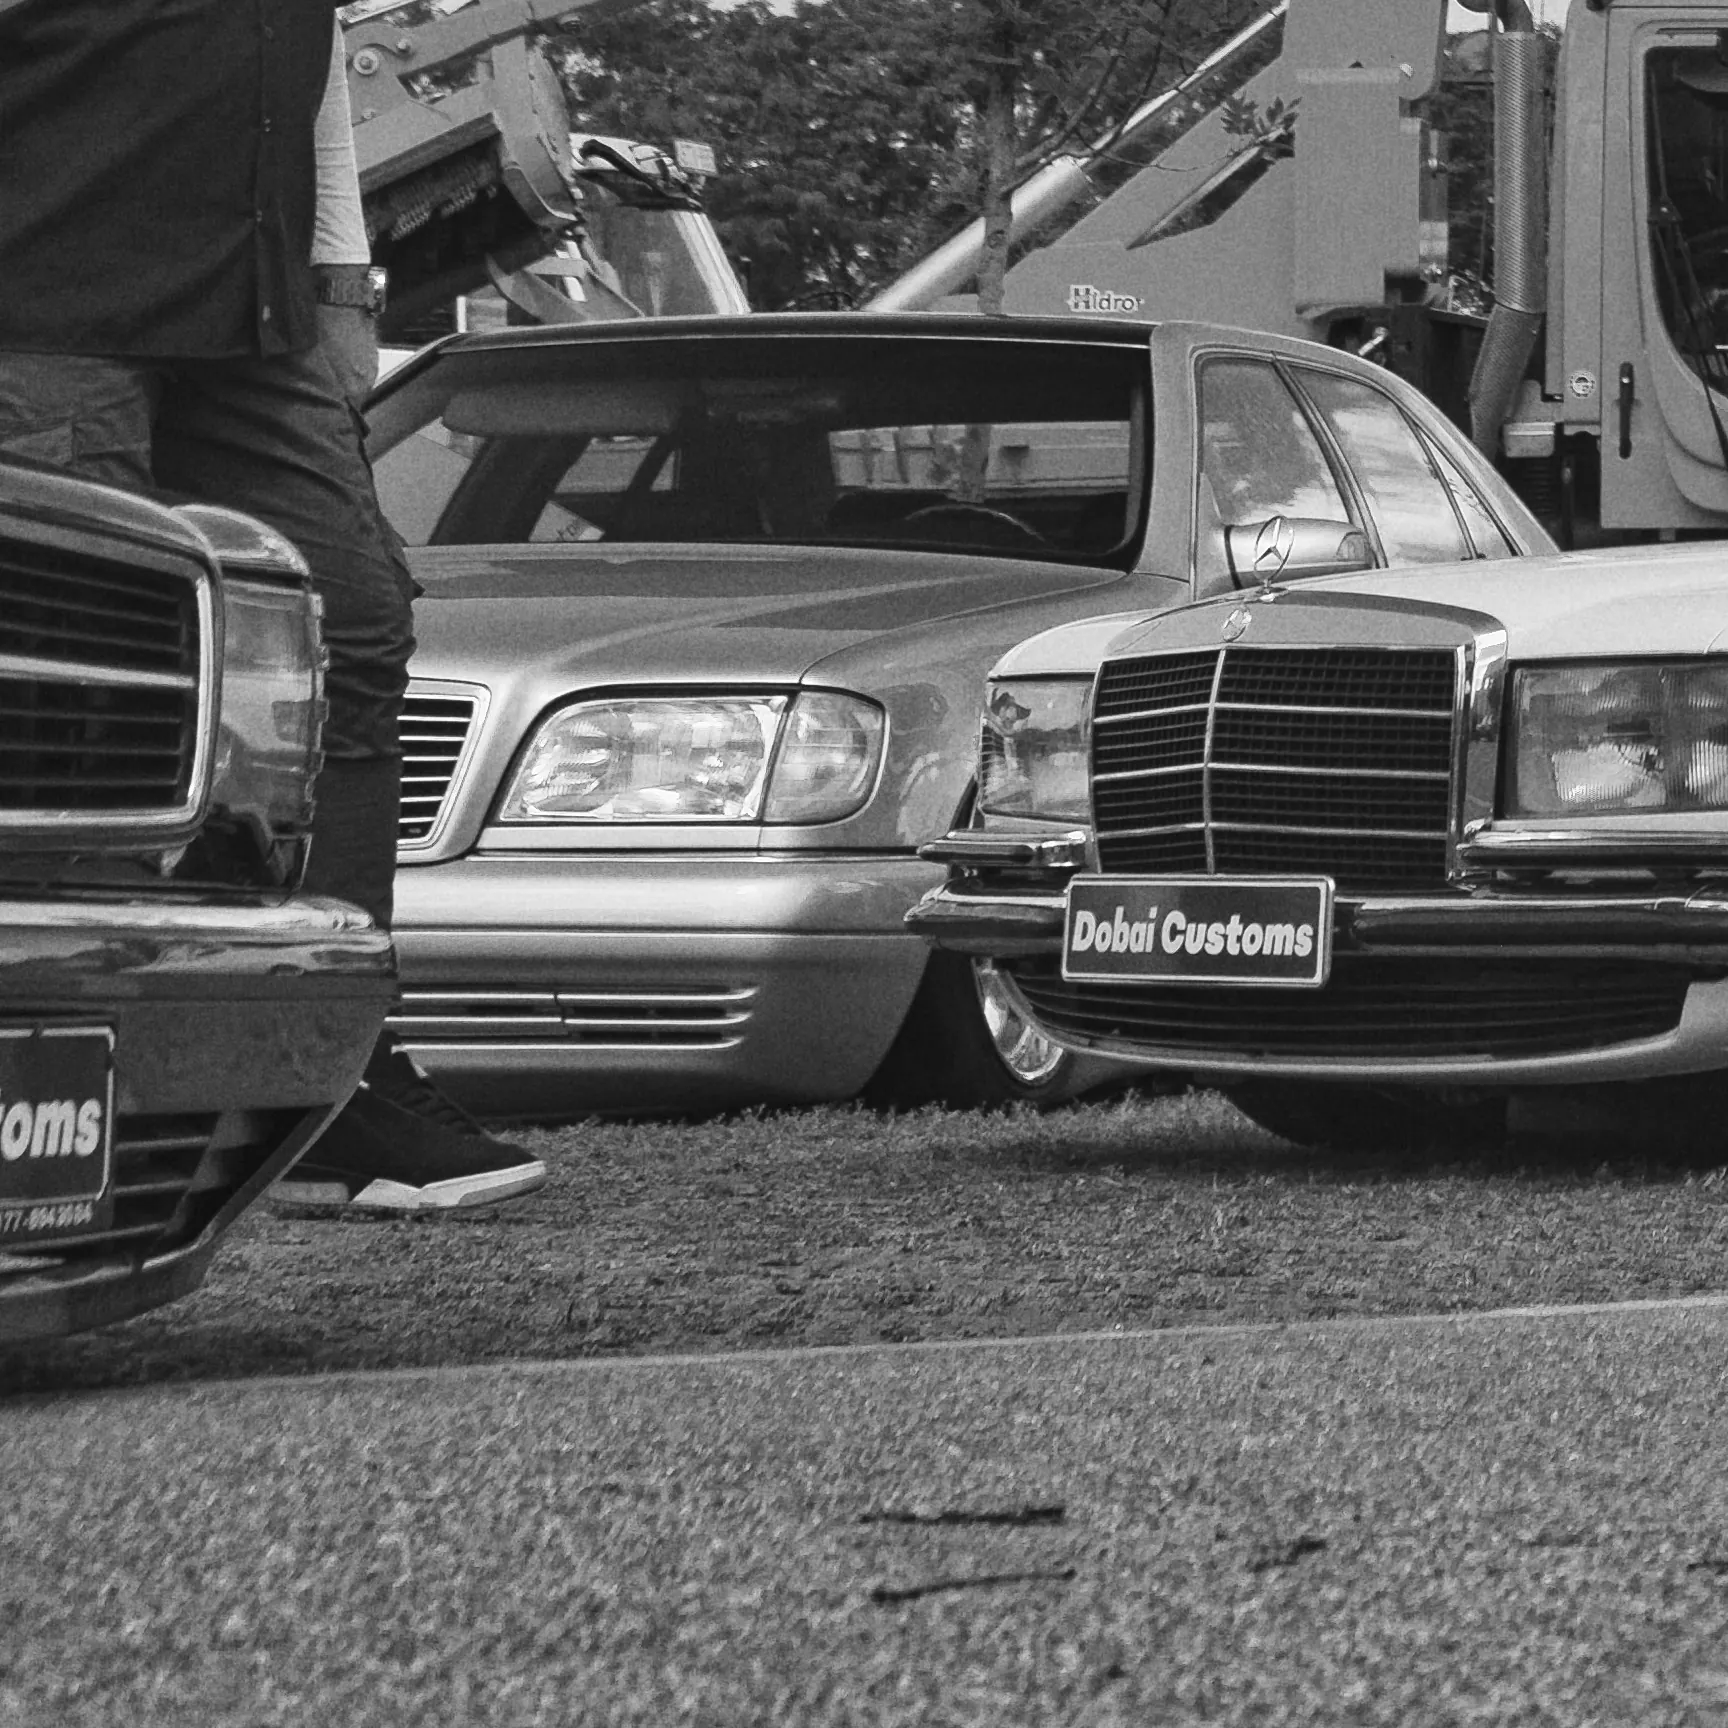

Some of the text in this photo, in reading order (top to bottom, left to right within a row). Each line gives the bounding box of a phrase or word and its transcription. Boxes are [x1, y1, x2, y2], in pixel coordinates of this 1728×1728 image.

[1072, 906, 1314, 956] Dobai Customs
[0, 1094, 102, 1161] oms
